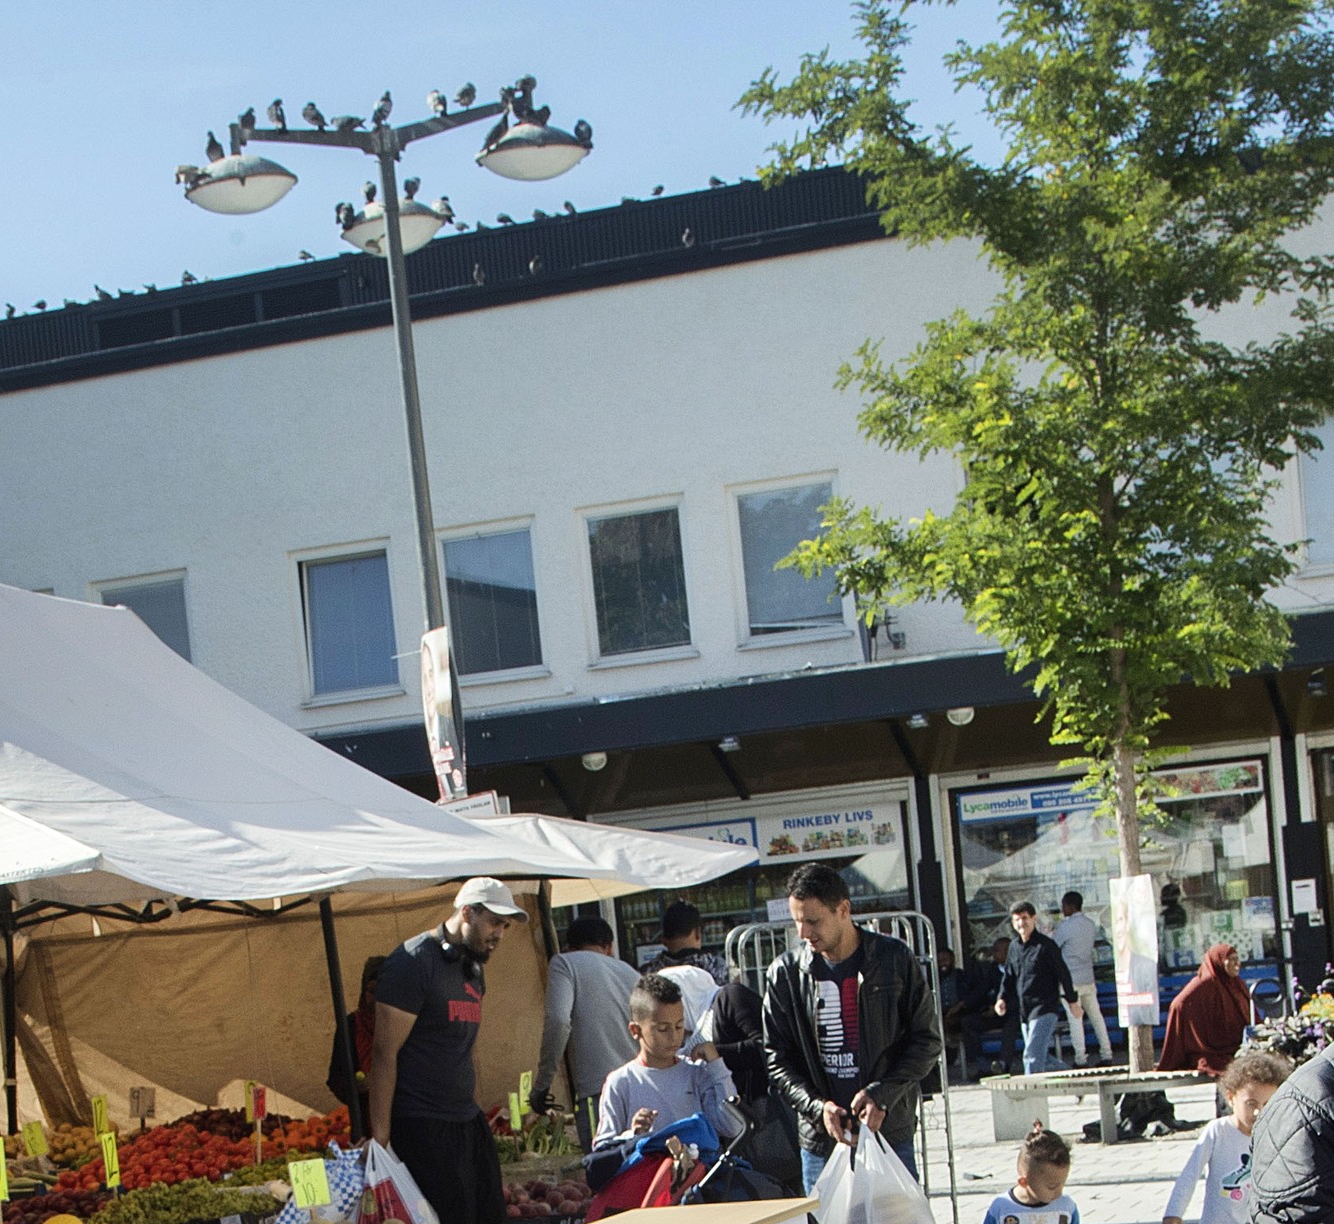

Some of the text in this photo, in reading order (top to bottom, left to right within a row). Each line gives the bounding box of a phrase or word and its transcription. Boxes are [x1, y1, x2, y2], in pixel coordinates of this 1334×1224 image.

[963, 795, 1028, 814] Lycamobile
[782, 810, 873, 830] RINKEBY LIVS
[820, 1053, 855, 1067] PERIOR
